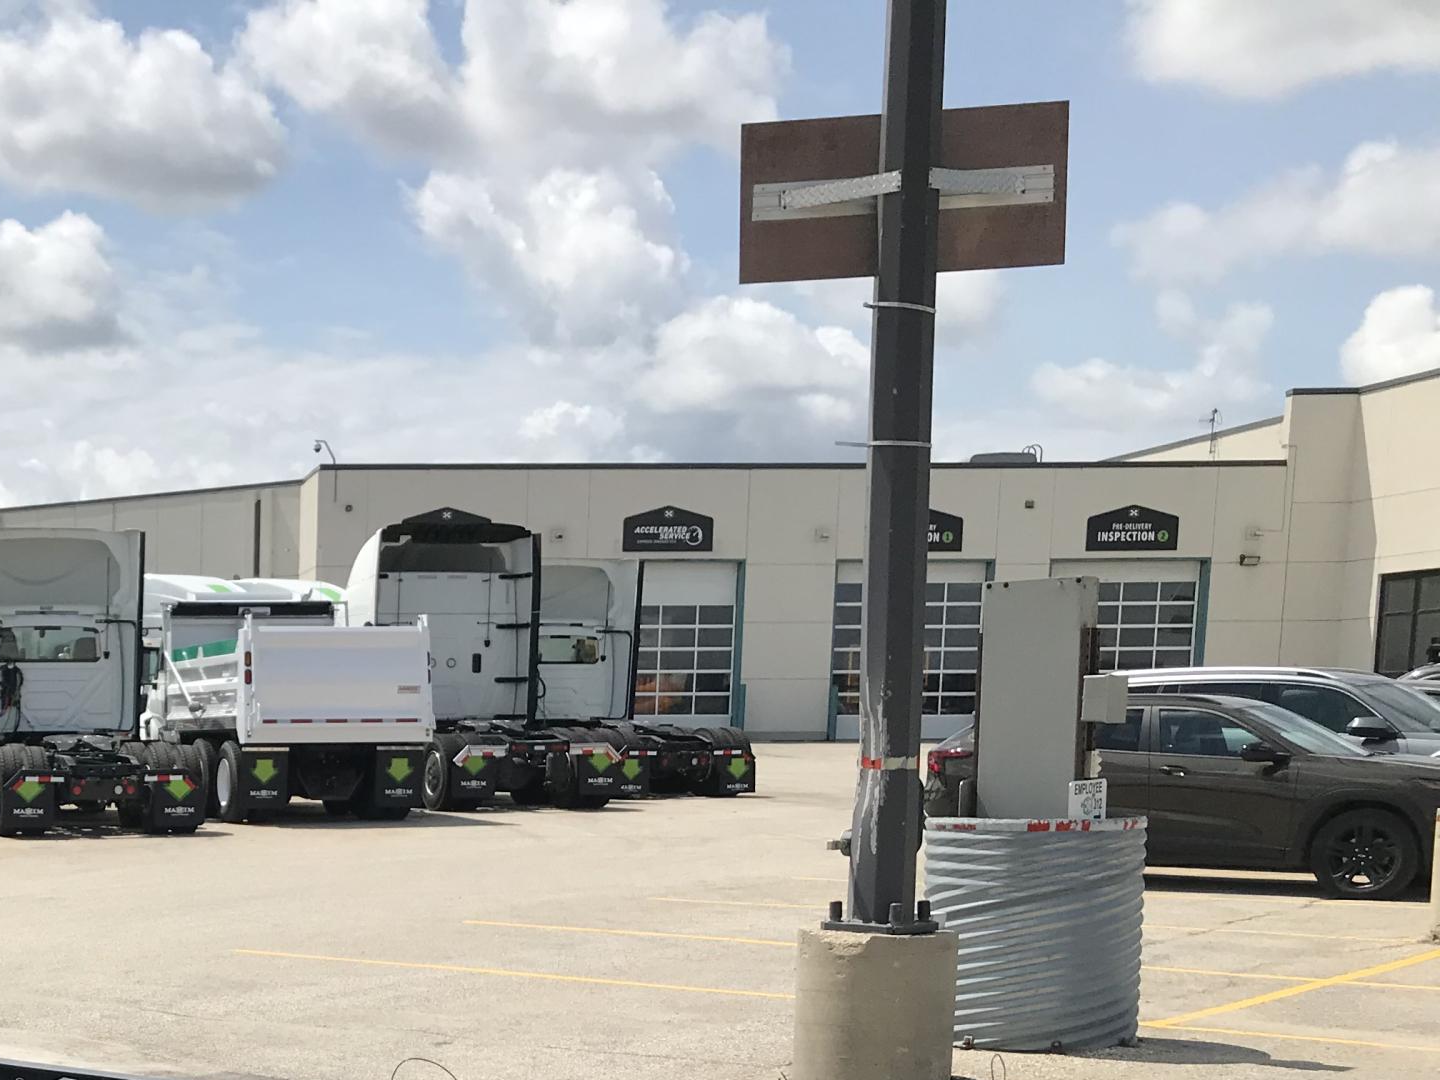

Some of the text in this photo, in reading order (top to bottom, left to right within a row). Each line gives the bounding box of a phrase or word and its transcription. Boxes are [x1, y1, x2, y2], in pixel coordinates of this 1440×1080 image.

[634, 525, 688, 534] ACCELERATED
[1111, 522, 1153, 531] PRE-DELIVERY
[658, 532, 691, 540] SERVICE
[1097, 530, 1155, 541] INSPECTION
[1074, 781, 1103, 795] EMPLOYEE
